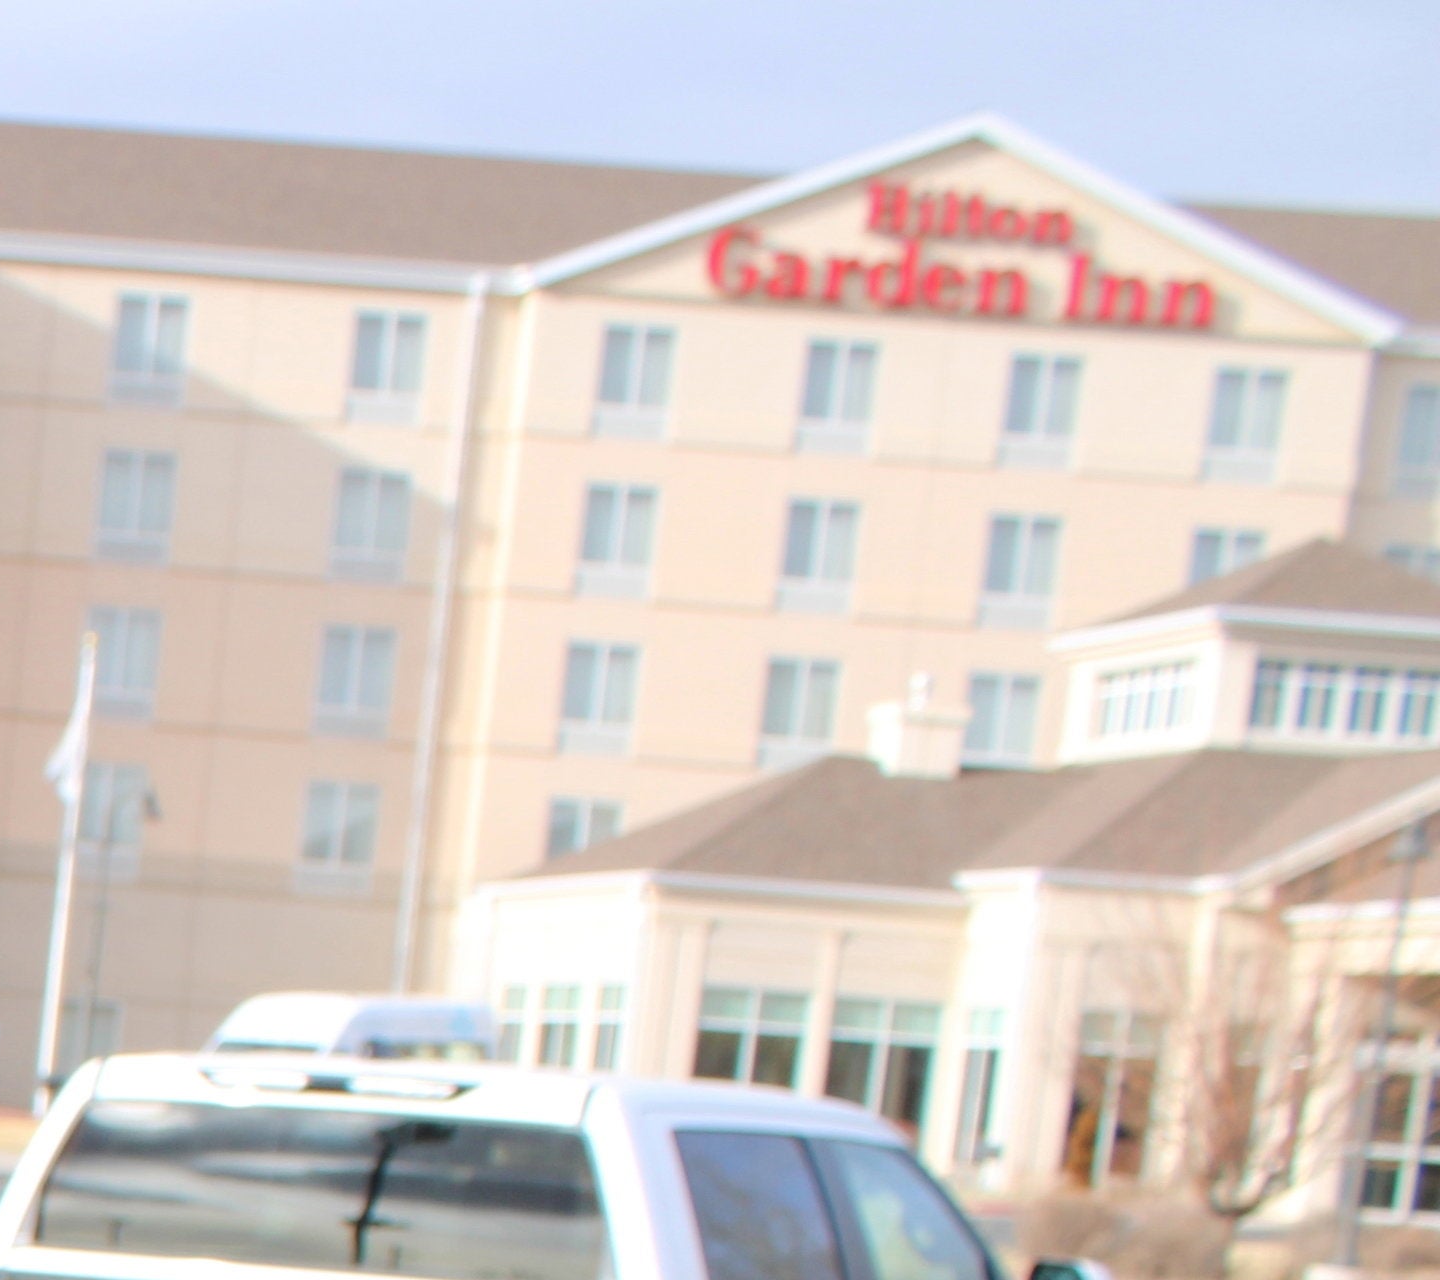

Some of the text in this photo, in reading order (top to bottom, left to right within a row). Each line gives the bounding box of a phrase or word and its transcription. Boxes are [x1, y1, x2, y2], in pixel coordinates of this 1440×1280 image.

[863, 180, 1074, 246] Hilton
[706, 226, 1216, 329] Garden Inn
